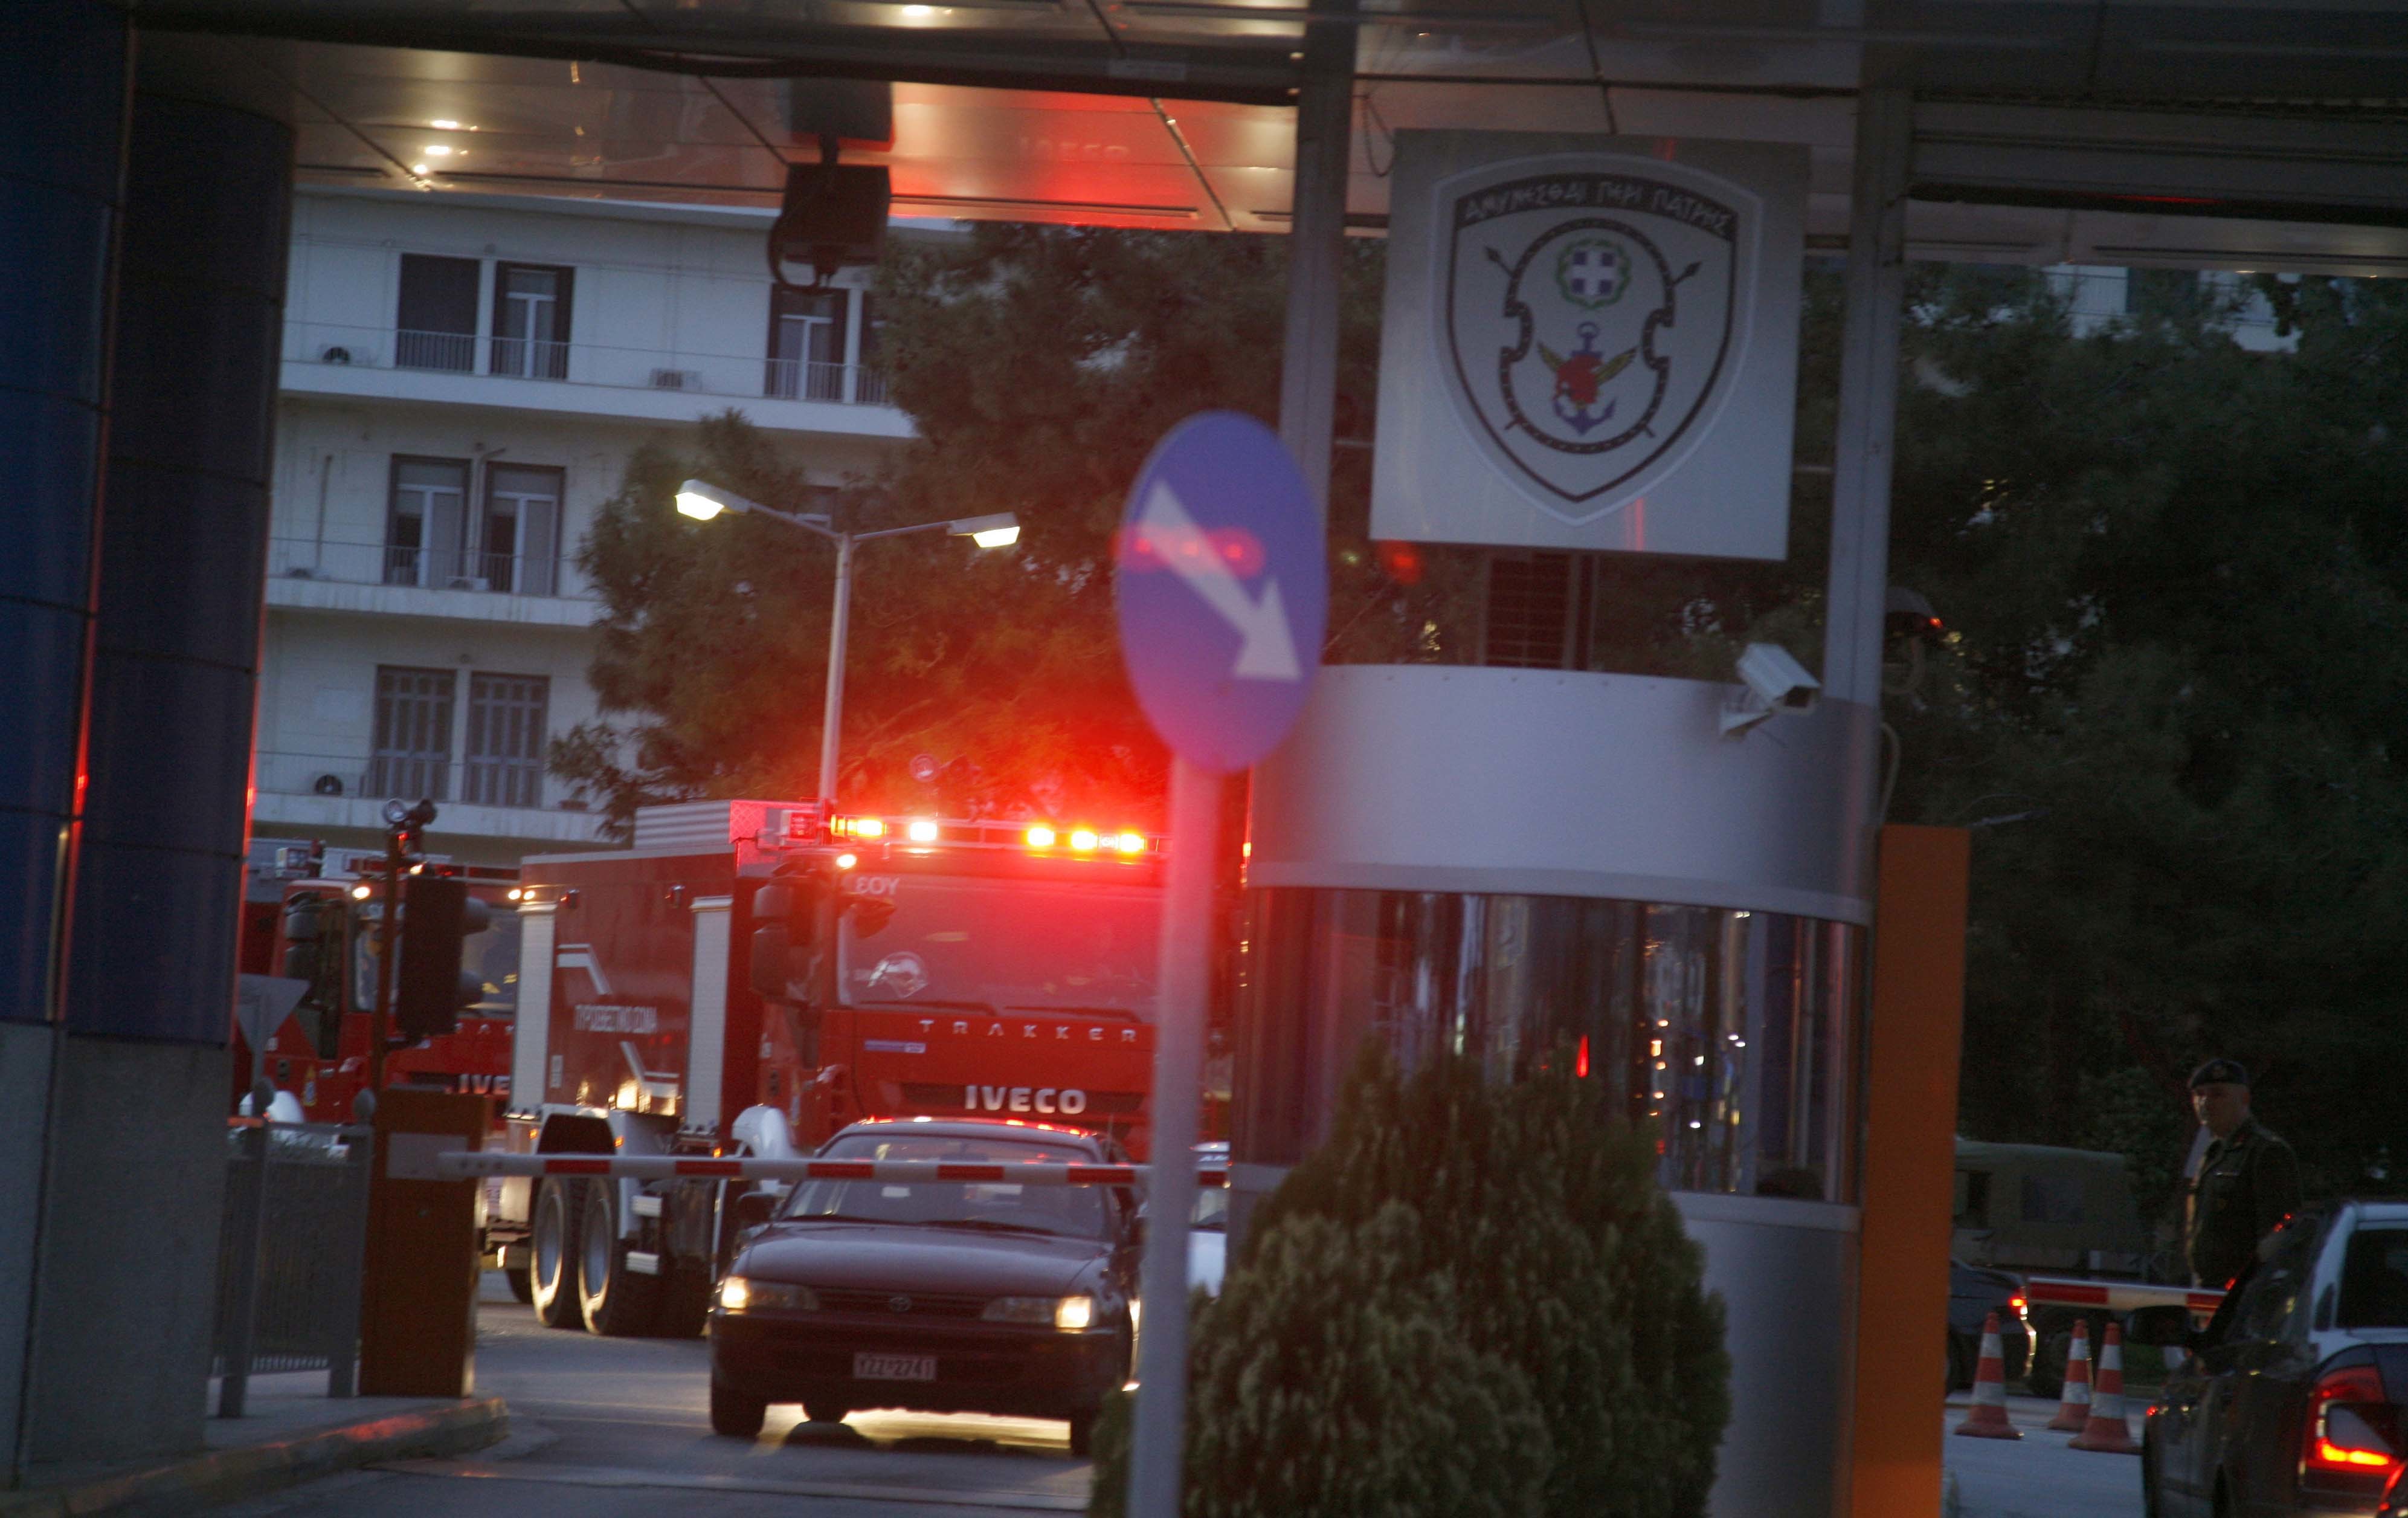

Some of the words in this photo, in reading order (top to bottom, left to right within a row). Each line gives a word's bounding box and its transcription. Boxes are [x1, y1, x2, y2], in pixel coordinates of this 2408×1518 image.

[919, 1019, 1137, 1042] TRAKKER
[457, 1073, 511, 1095] IVE
[965, 1085, 1087, 1114] IVECO
